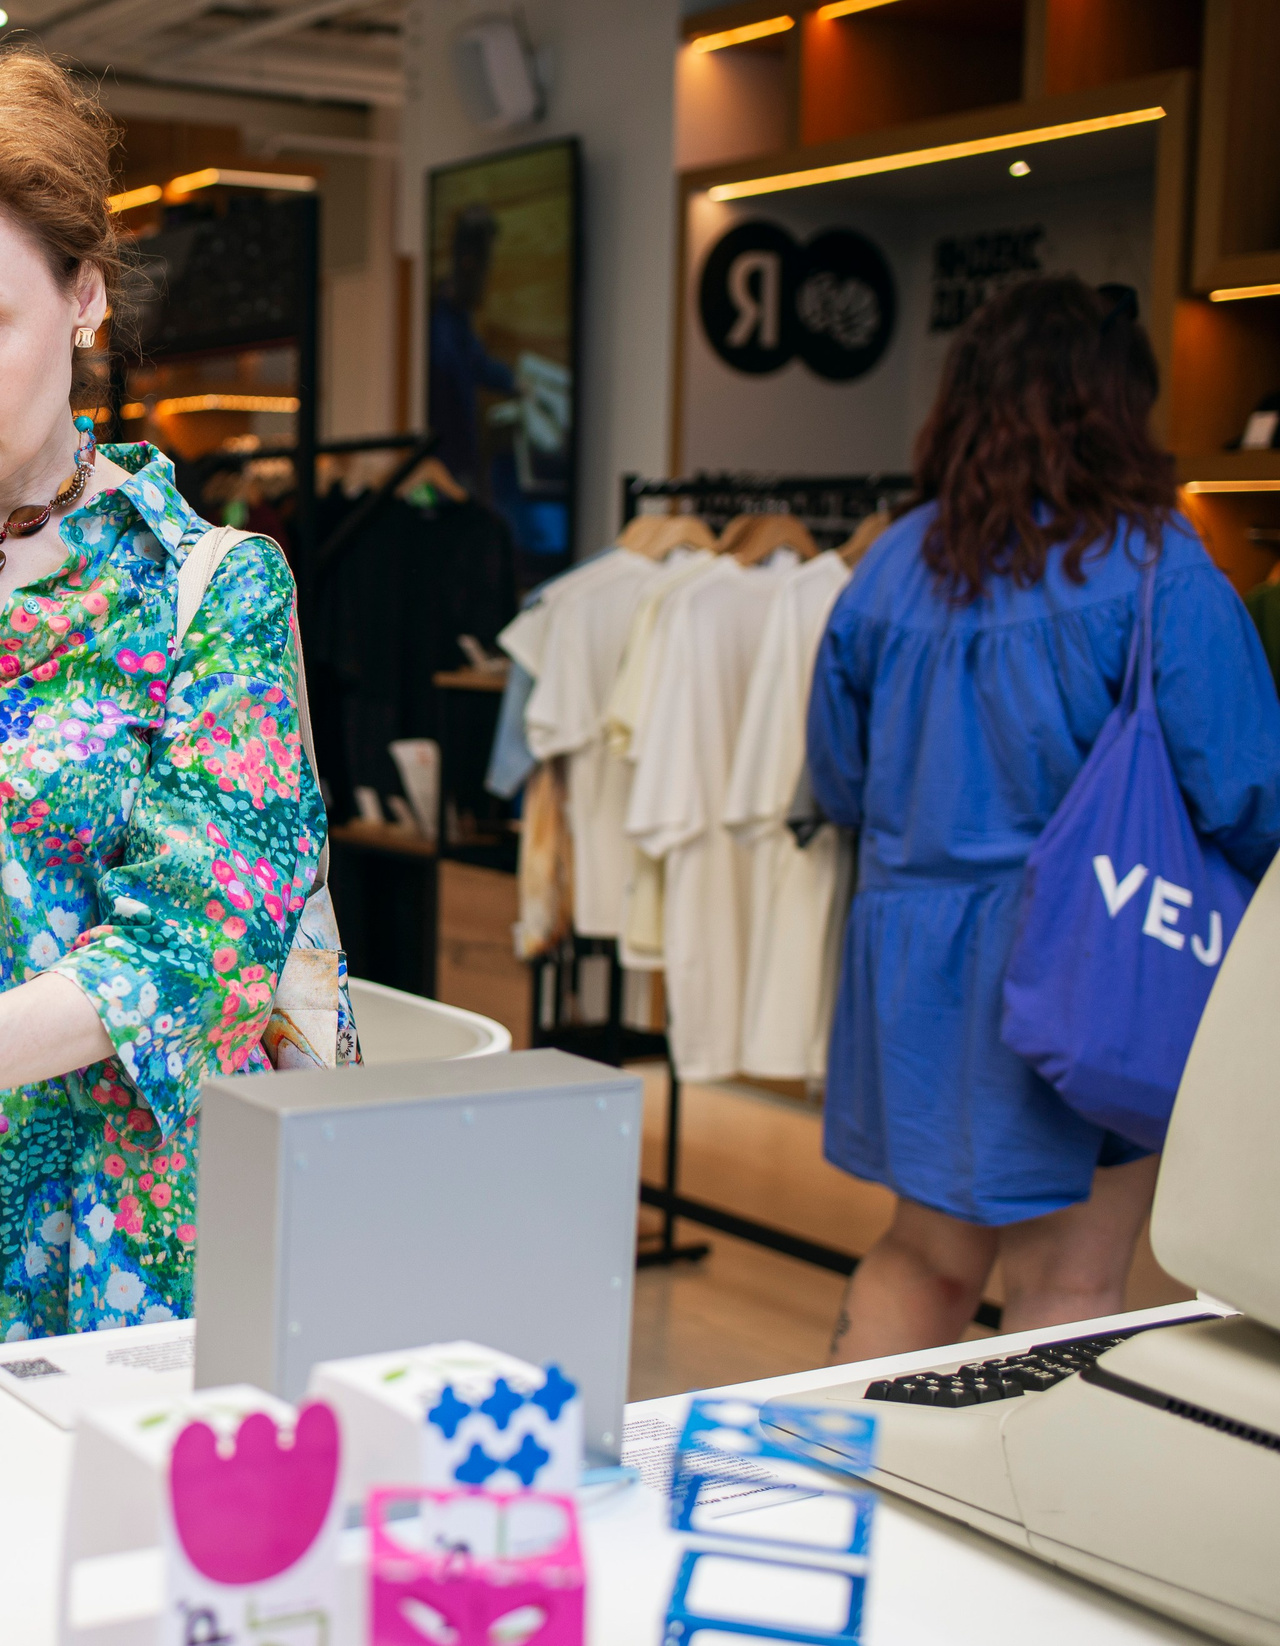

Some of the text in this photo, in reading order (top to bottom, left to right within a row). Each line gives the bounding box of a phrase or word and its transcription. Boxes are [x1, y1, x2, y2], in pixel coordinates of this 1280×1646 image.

[727, 251, 781, 347] Я
[1092, 854, 1223, 967] VEJ
[721, 1483, 797, 1500] Cmmodore
